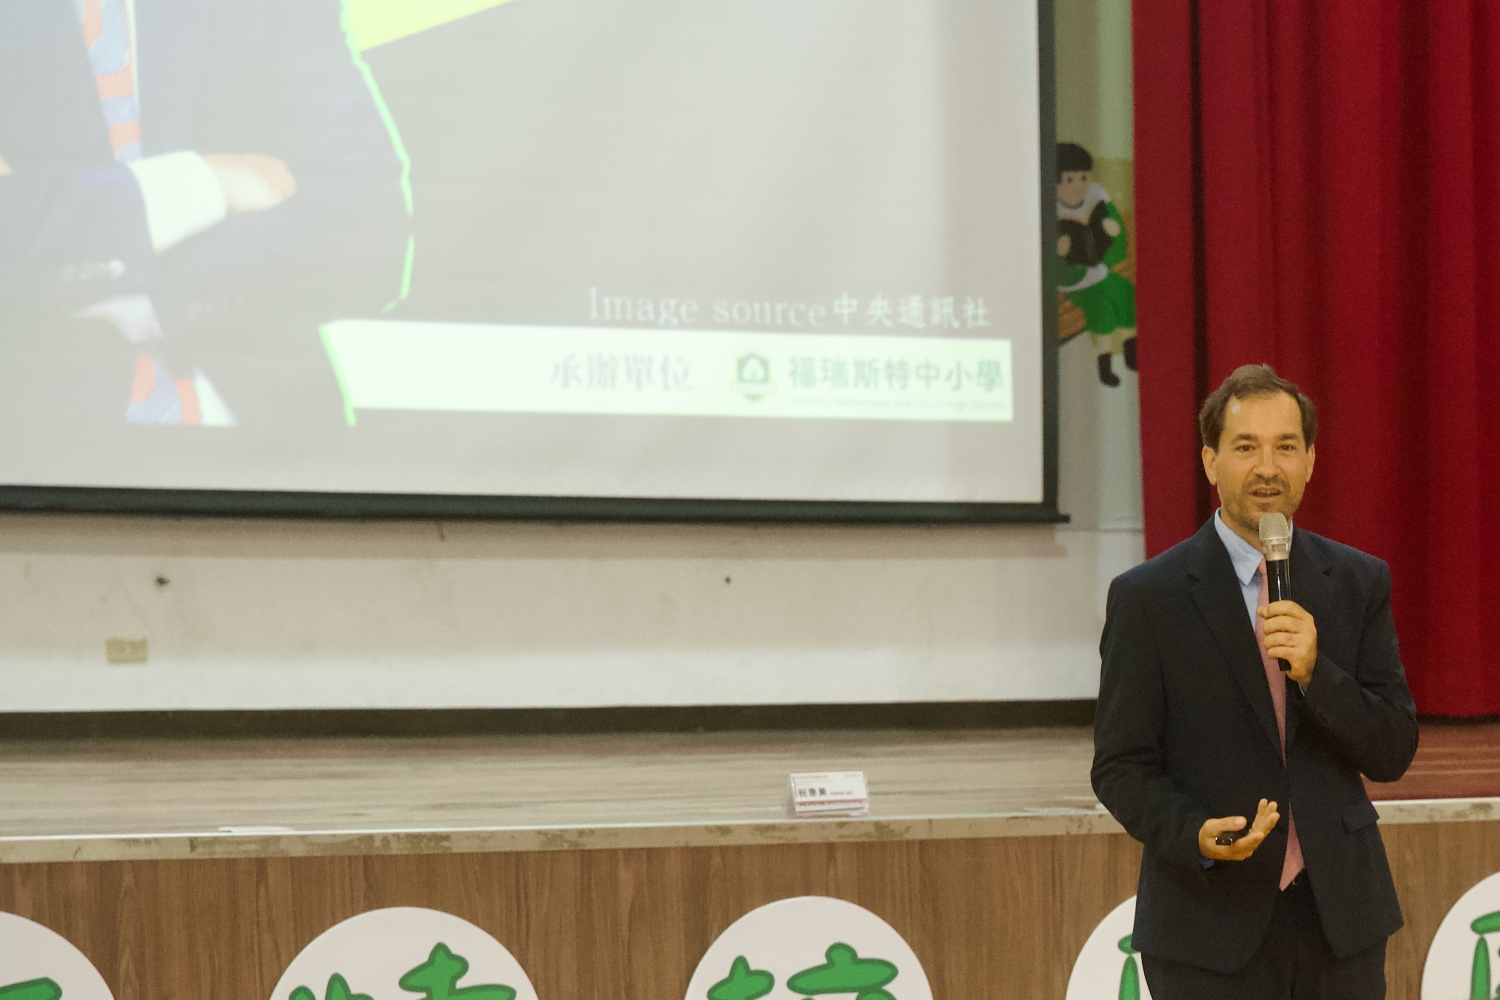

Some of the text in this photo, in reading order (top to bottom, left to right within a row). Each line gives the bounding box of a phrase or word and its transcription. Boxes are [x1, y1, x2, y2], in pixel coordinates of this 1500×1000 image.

[588, 286, 699, 327] Image
[713, 299, 827, 329] source
[550, 352, 693, 392] 承辦單位
[788, 356, 1004, 393] 福瑞斯特中小學
